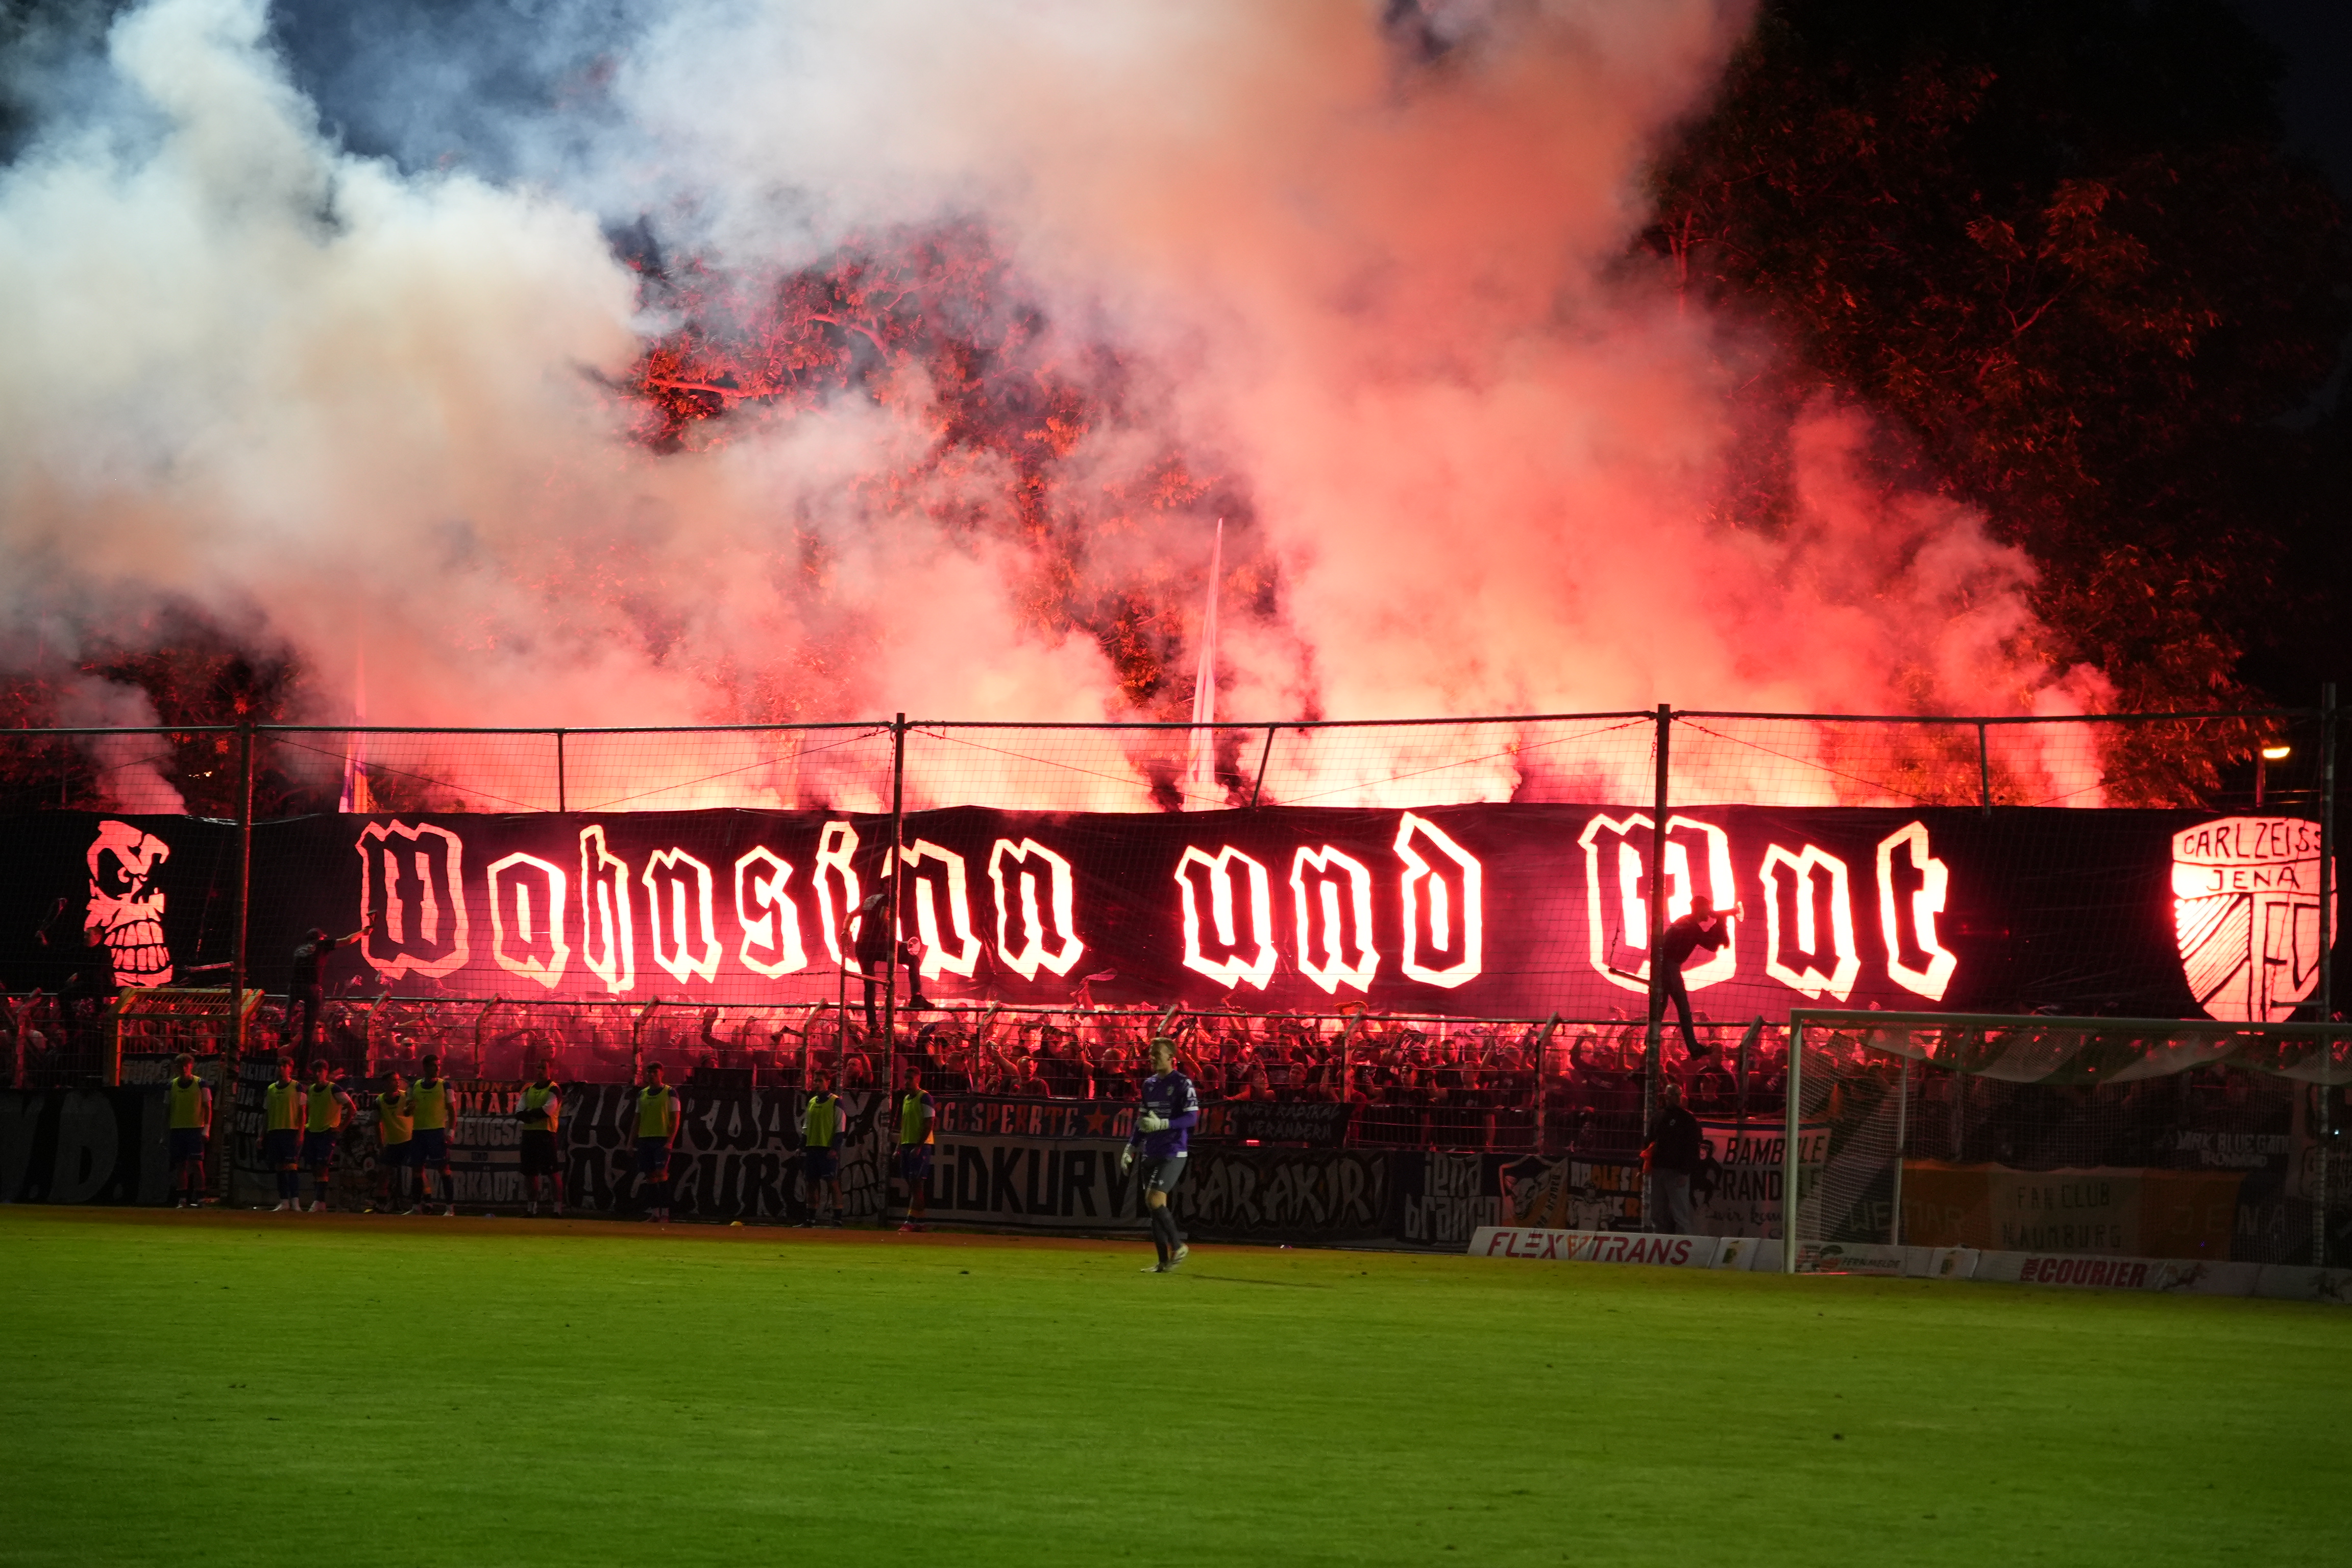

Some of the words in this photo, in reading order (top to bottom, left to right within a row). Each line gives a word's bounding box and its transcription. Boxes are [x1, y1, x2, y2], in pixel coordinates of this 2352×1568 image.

[2207, 866, 2300, 892] JENA
[1174, 811, 1482, 994] und
[1577, 812, 1958, 1002] Wut
[1247, 1120, 1332, 1141] VERÄNDERN
[1723, 1136, 1825, 1166] BAMBLE
[1723, 1168, 1822, 1202] RANDLE
[2061, 1181, 2111, 1209] CLUB
[1487, 1231, 1564, 1260] FLEX
[1591, 1236, 1693, 1265] TRANS
[2002, 1222, 2122, 1250] NAUMBURG
[2037, 1258, 2148, 1288] COURIER
